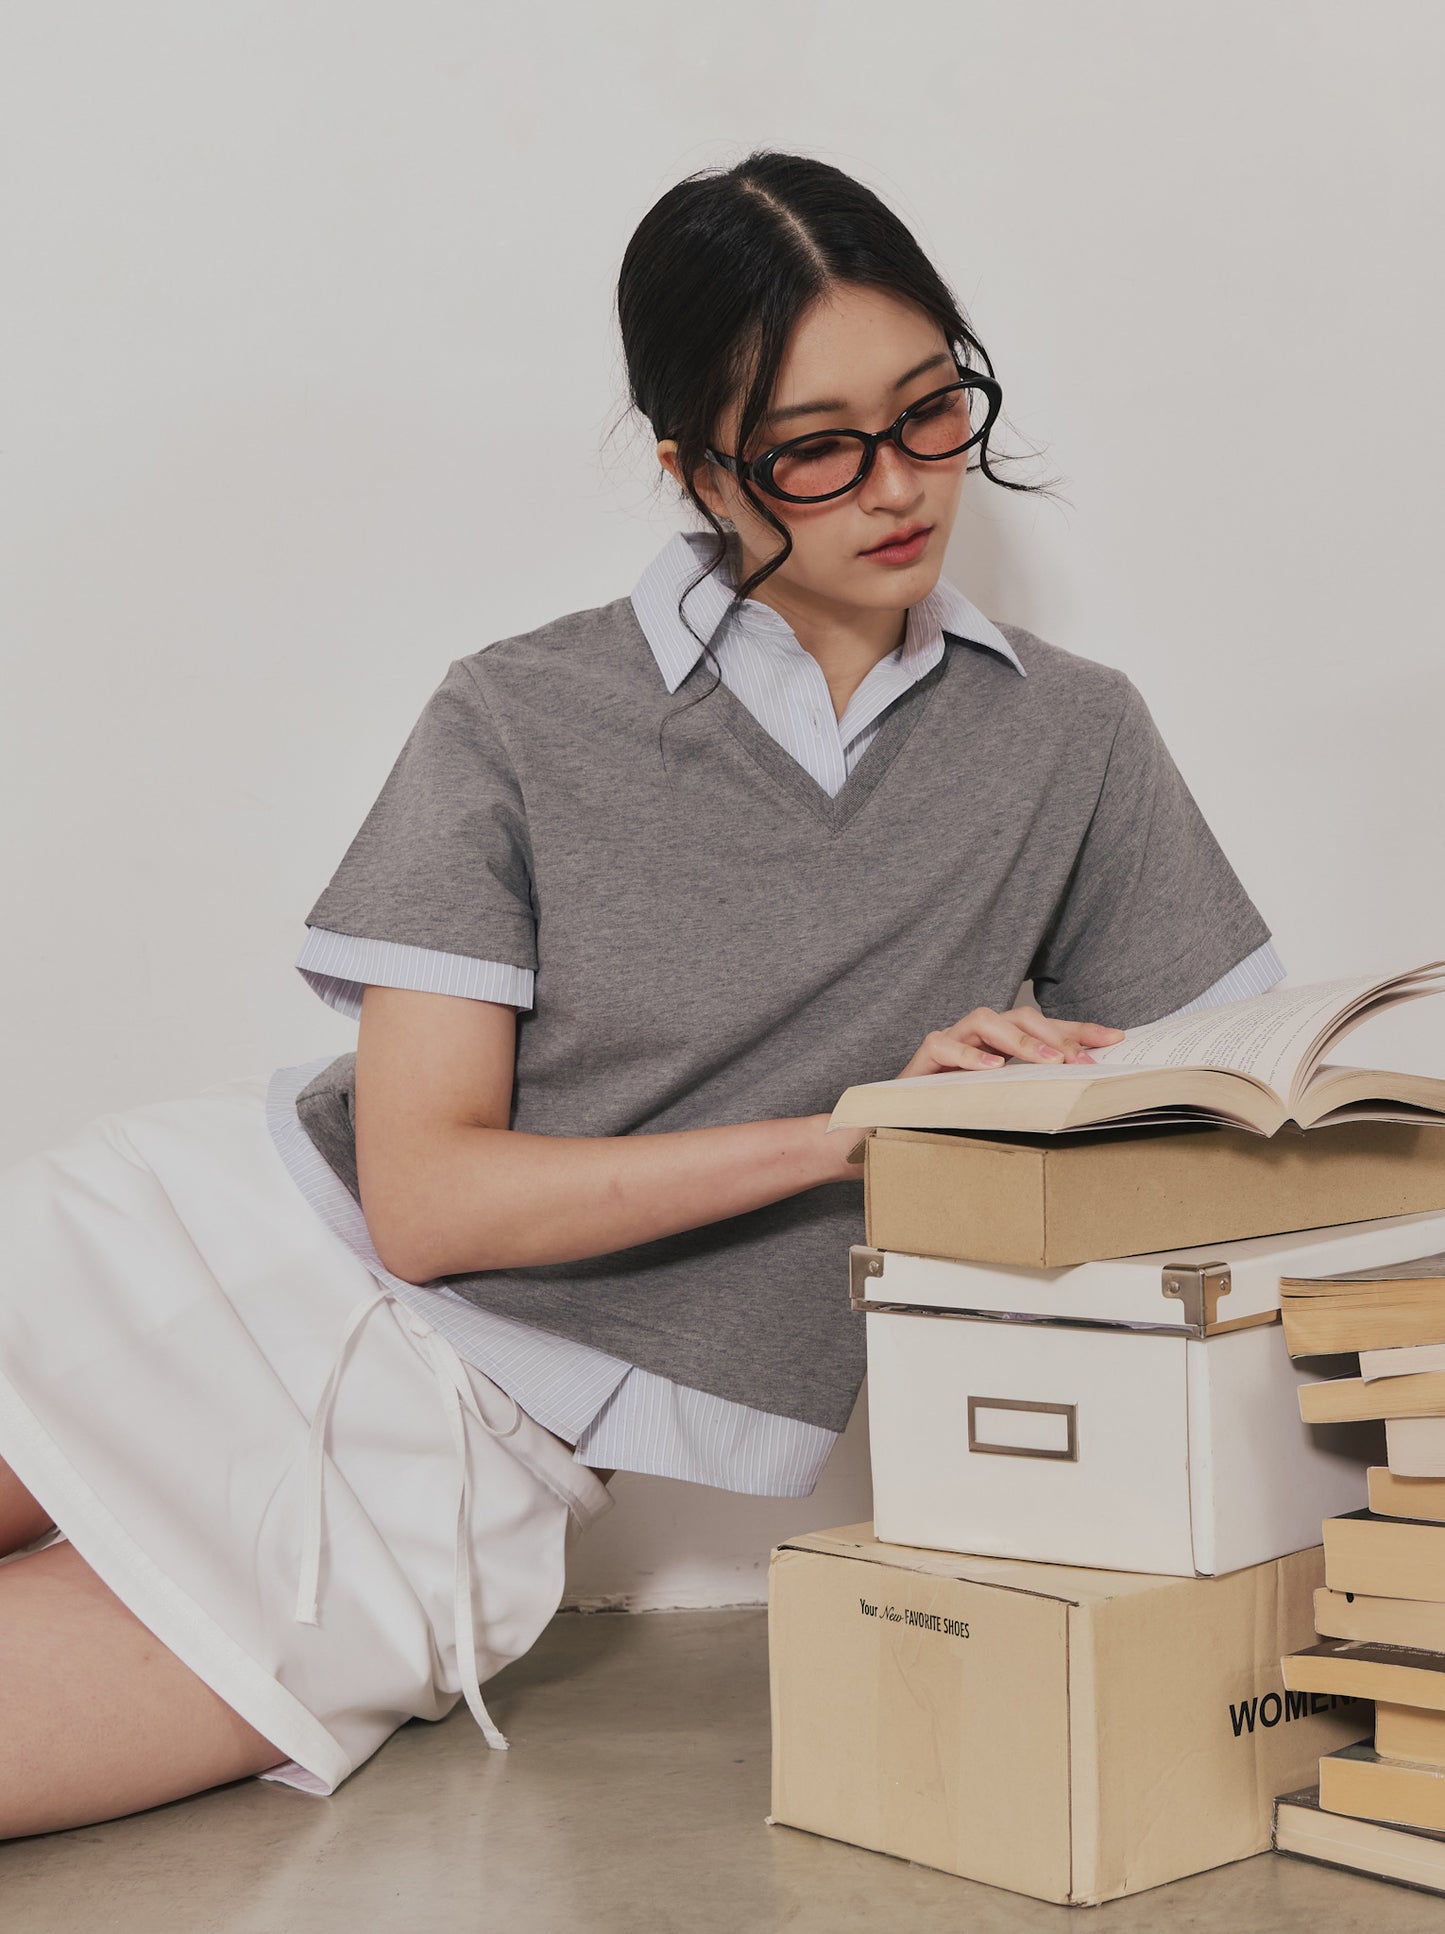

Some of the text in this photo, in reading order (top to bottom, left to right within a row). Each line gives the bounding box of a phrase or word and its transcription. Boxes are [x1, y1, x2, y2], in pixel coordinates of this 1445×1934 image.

[859, 1598, 970, 1639] Your New FAVORITE SHOES
[1229, 1691, 1356, 1737] WOME
